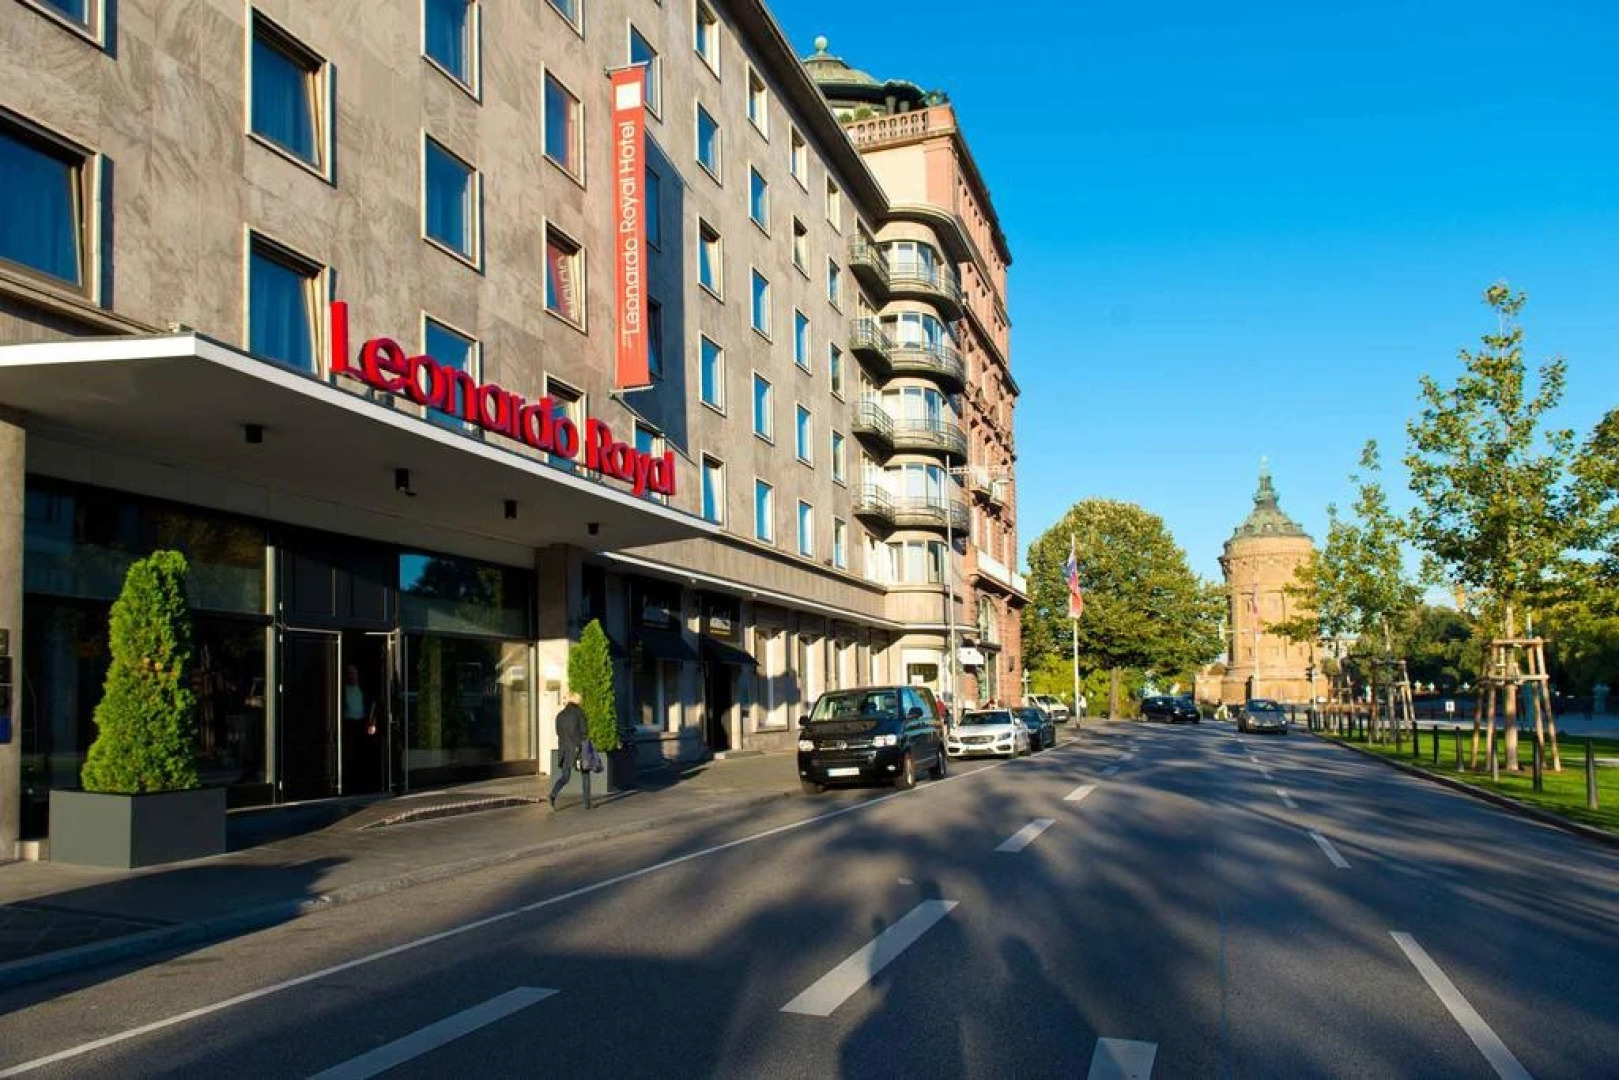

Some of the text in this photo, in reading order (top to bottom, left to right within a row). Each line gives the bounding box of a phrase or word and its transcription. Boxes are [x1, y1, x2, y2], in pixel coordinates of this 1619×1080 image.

[618, 120, 640, 333] Leonardo Royal Hotel
[330, 300, 676, 498] Leonardo Royal
